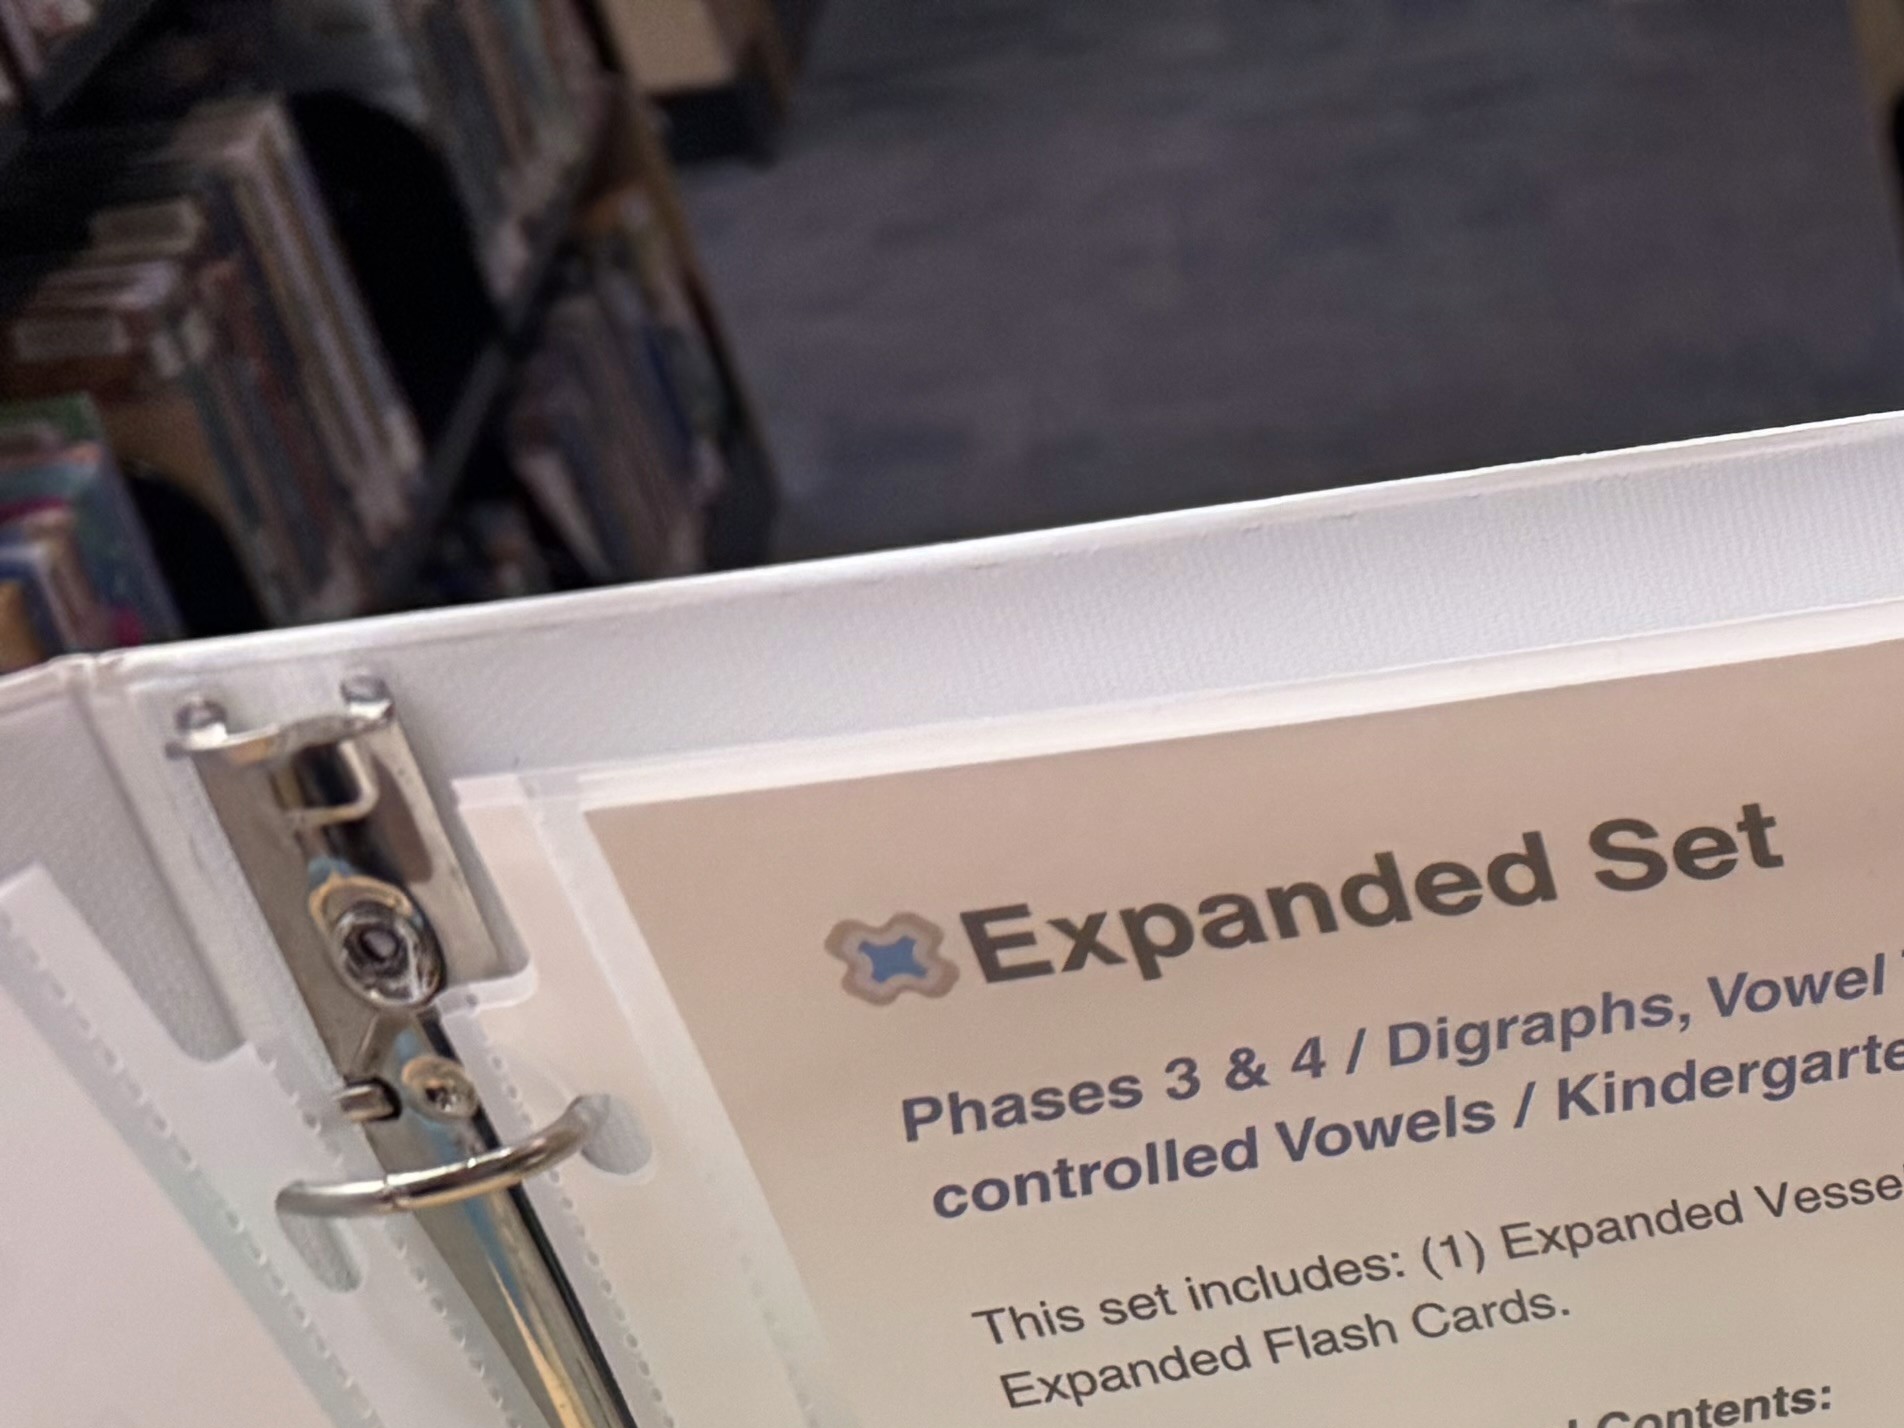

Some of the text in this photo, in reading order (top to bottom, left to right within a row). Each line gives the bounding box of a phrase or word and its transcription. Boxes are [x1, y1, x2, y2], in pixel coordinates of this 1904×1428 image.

[958, 801, 1786, 985] Expanded Set
[900, 1073, 1145, 1144] Phases
[1163, 1055, 1202, 1102] 3
[1223, 1045, 1272, 1093] &
[1289, 1034, 1328, 1080] 4
[1344, 1026, 1367, 1076] /
[1387, 990, 1692, 1069] Digraphs,
[1706, 951, 1886, 1019] Vowel
[931, 1124, 1260, 1220] controlled
[1273, 1093, 1497, 1164] Vowels
[1512, 1080, 1537, 1130] /
[969, 1299, 1087, 1346] This
[1098, 1283, 1178, 1327] set
[1183, 1251, 1406, 1312] includes:
[1420, 1229, 1487, 1282] (1)
[1499, 1188, 1745, 1261] Expanded
[998, 1287, 1571, 1410] Expanded Flash Cards.
